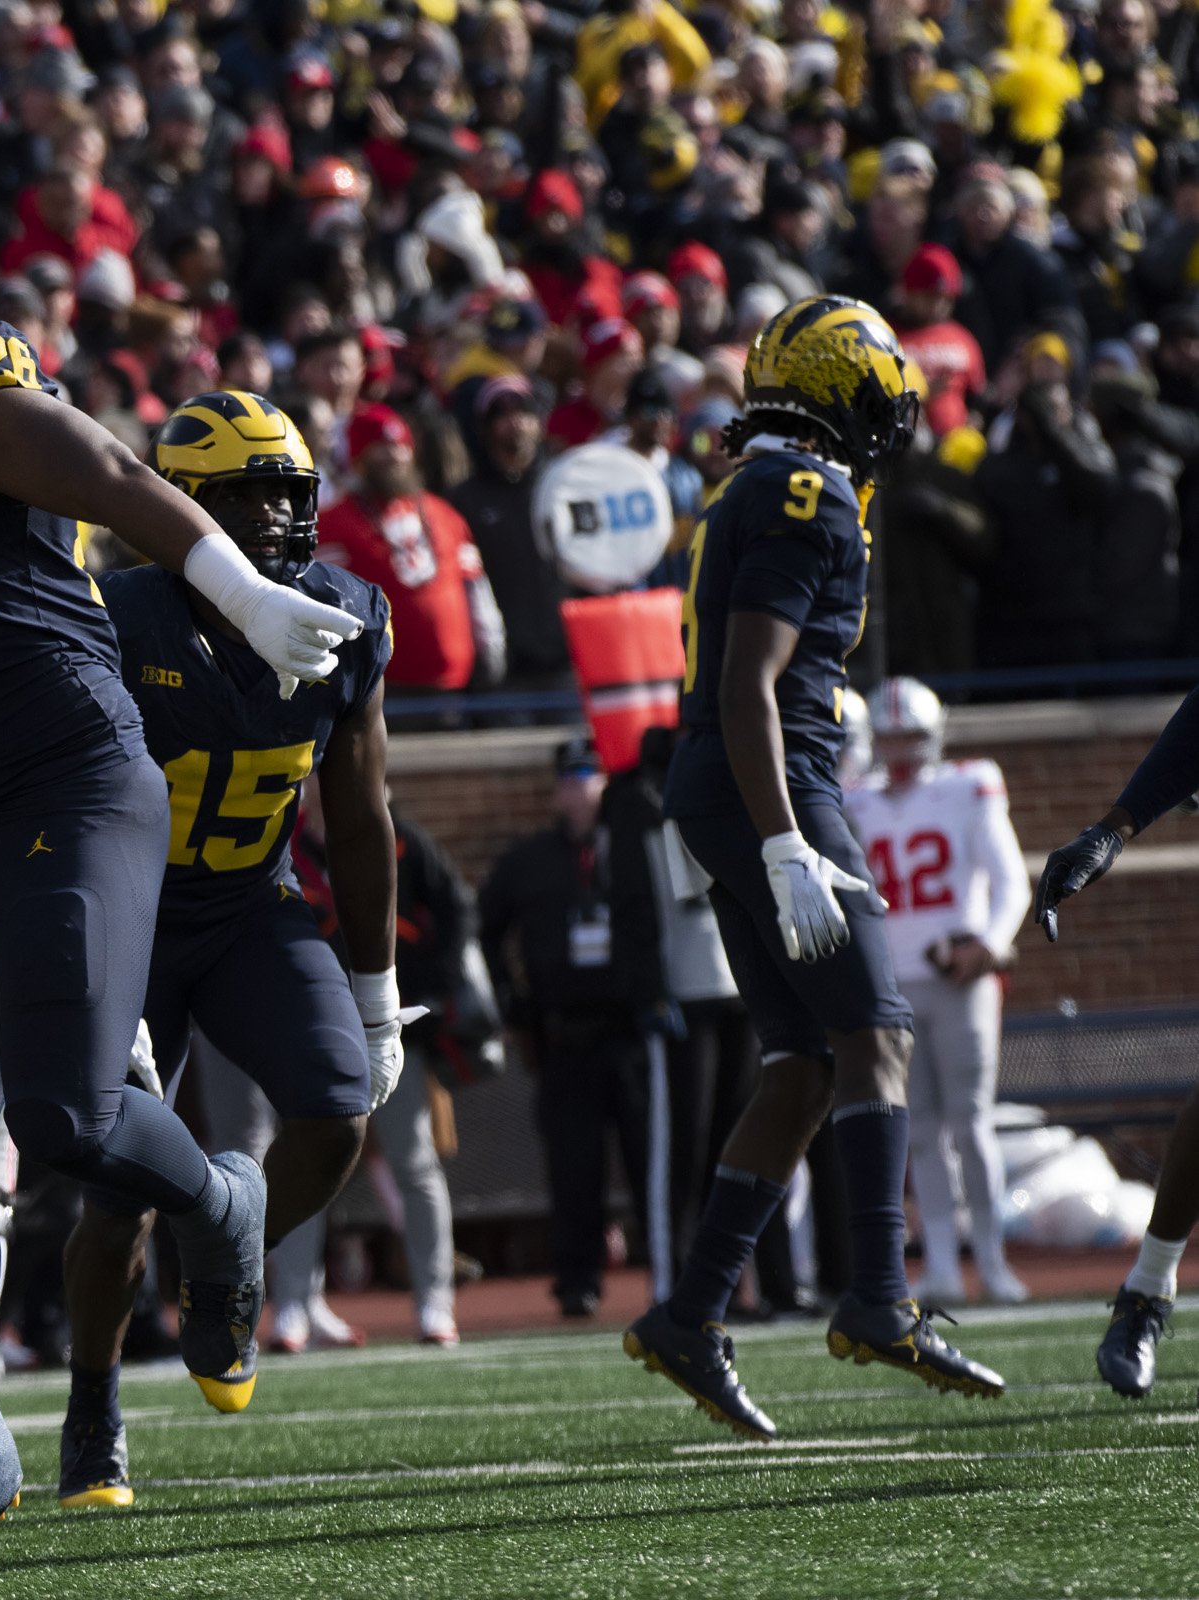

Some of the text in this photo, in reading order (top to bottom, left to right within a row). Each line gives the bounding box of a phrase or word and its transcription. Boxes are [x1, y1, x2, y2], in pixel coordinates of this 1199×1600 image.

[783, 470, 823, 521] 9
[163, 739, 316, 872] 15
[867, 828, 955, 913] 42
